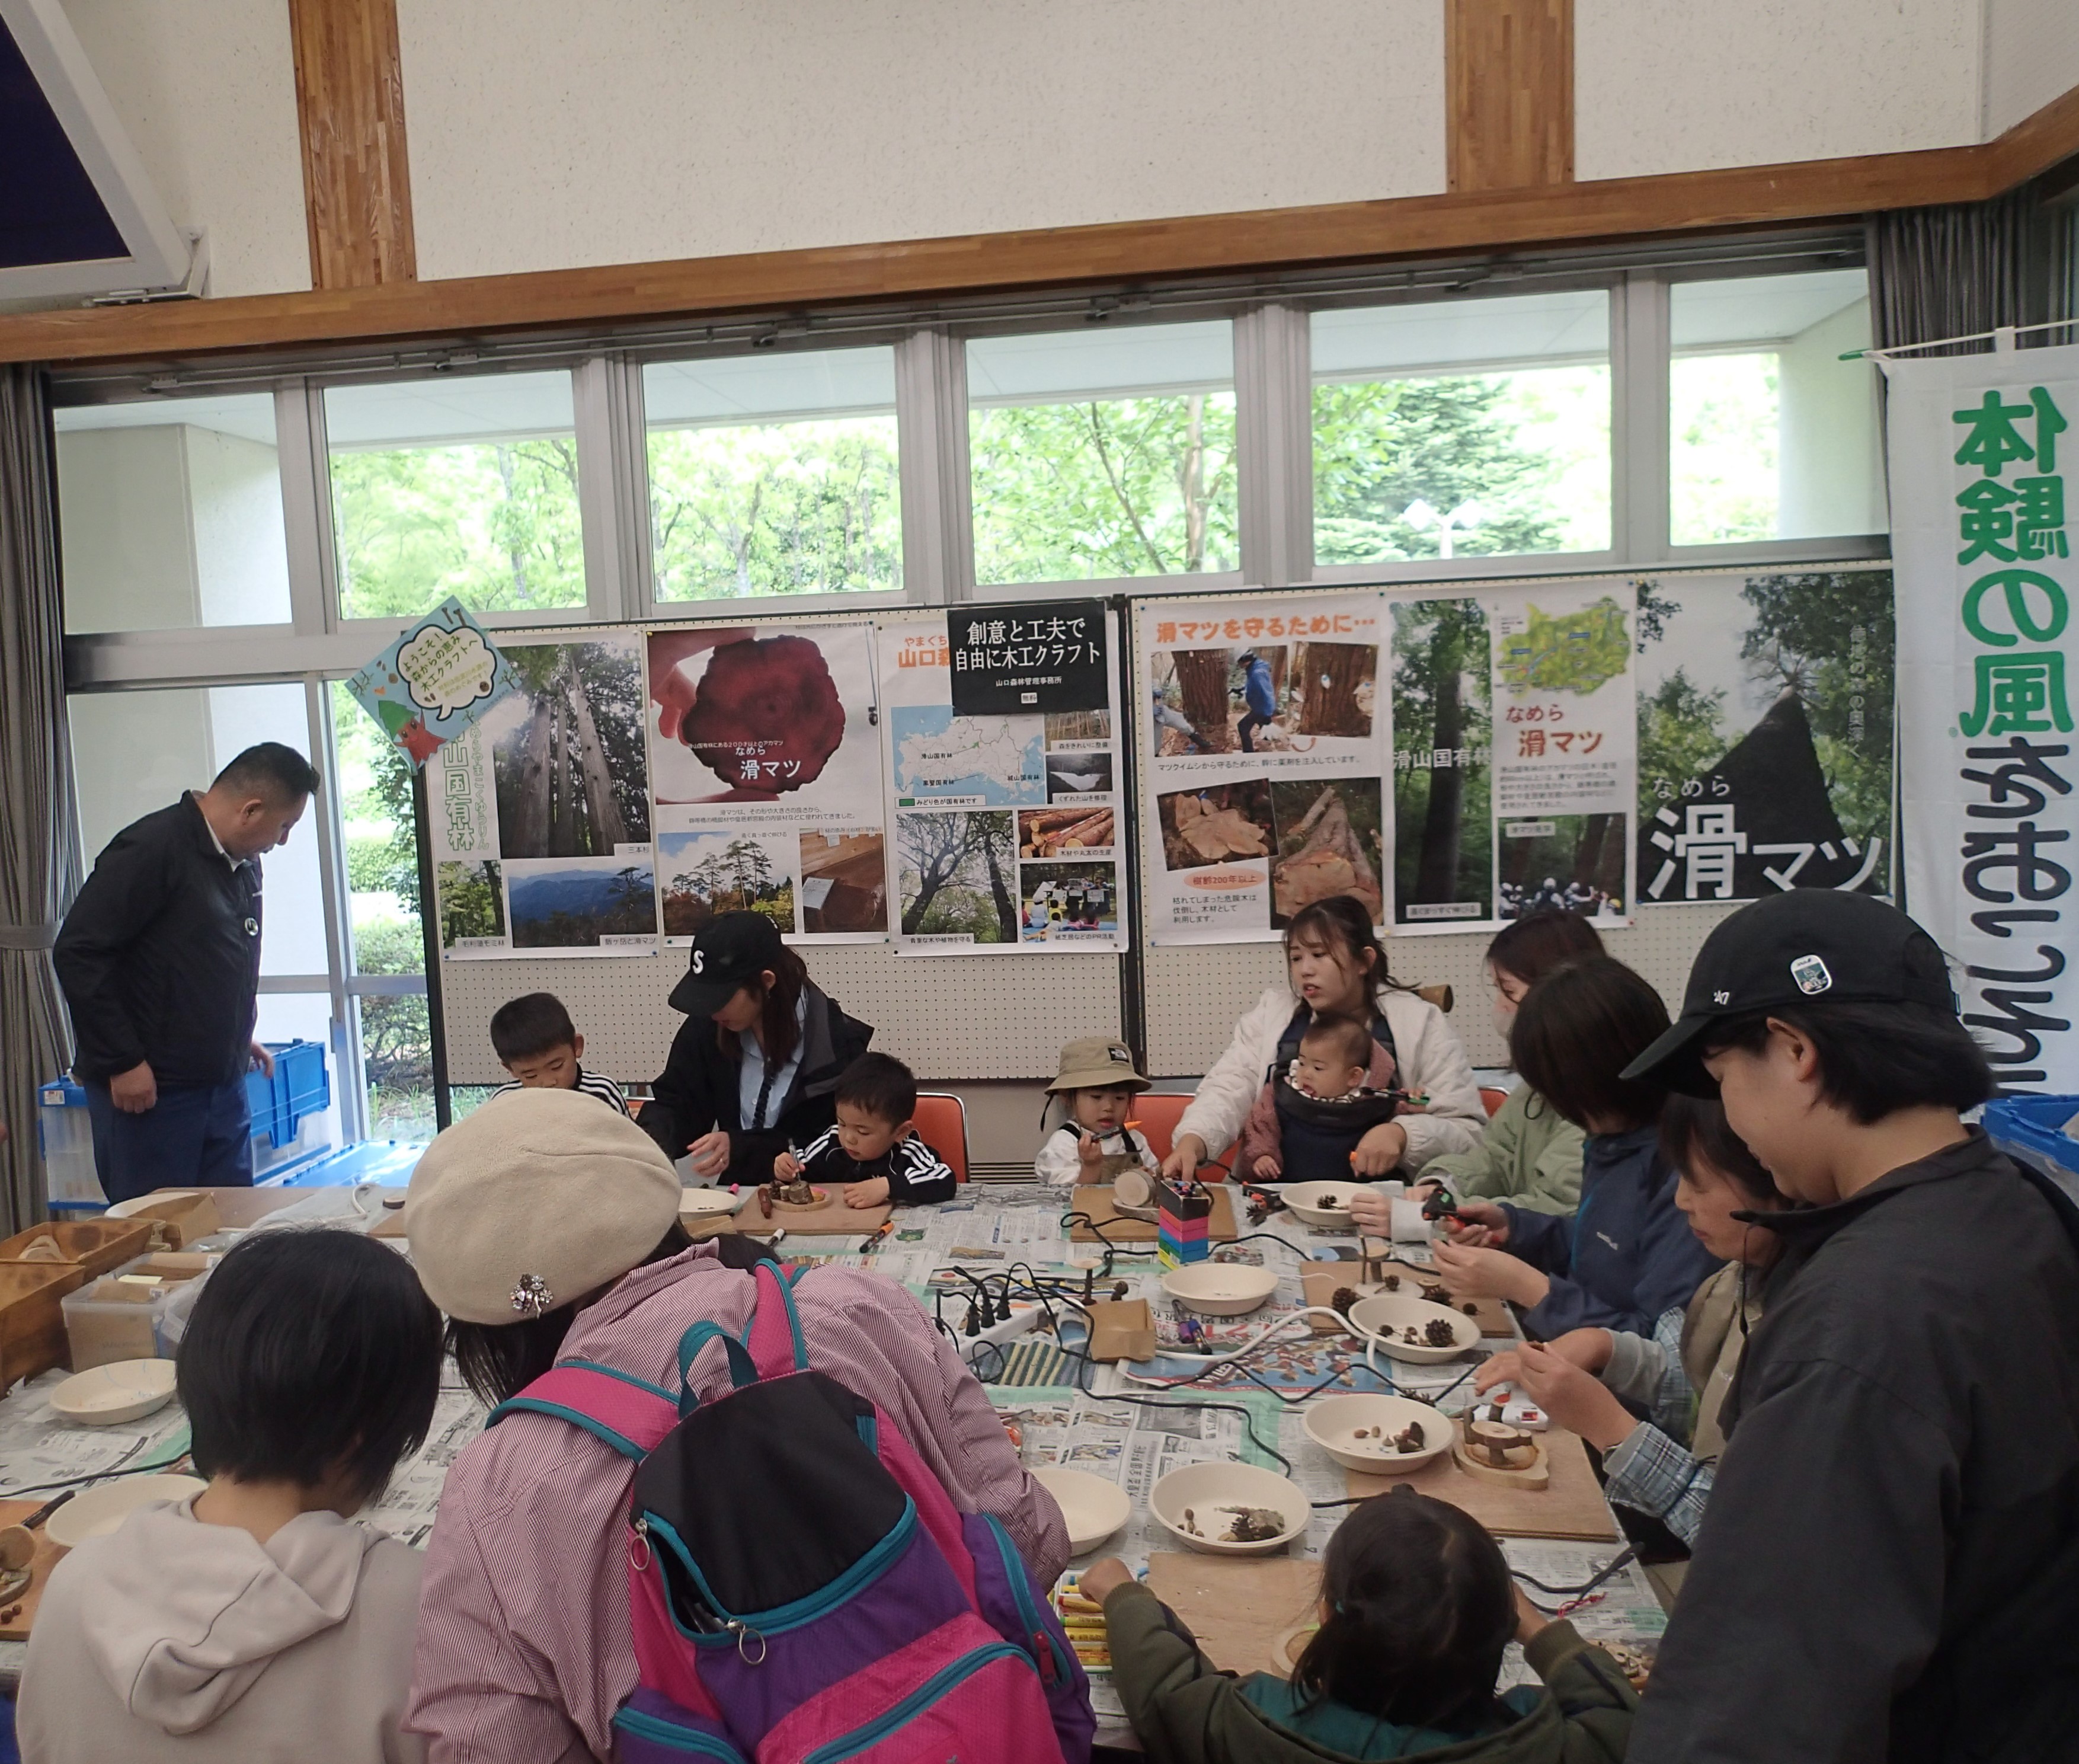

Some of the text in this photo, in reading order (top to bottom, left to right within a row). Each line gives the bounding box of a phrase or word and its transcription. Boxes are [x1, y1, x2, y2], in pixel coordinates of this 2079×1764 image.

[967, 616, 1086, 645] 創意と工夫で
[403, 632, 442, 672] ようこそ！
[411, 635, 460, 681] 森からの恵み
[956, 641, 1100, 672] 自由に木工クラフト
[421, 640, 478, 692] 木工クラフトへ
[996, 676, 1062, 687] 山口森林管理事務所
[1506, 704, 1564, 723] なめら
[735, 747, 766, 756] なめら
[1518, 730, 1603, 758] 滑マツ
[741, 759, 801, 780] 滑マツ
[1393, 747, 1492, 769] 滑山国有林
[443, 730, 474, 851] 山国有林
[1652, 775, 1730, 798] なめら
[1648, 803, 1883, 899] 滑マツ
[1193, 875, 1256, 885] 樹齢200年以上
[1173, 894, 1256, 904] 枯れてしまった危険木は
[692, 950, 704, 974] S
